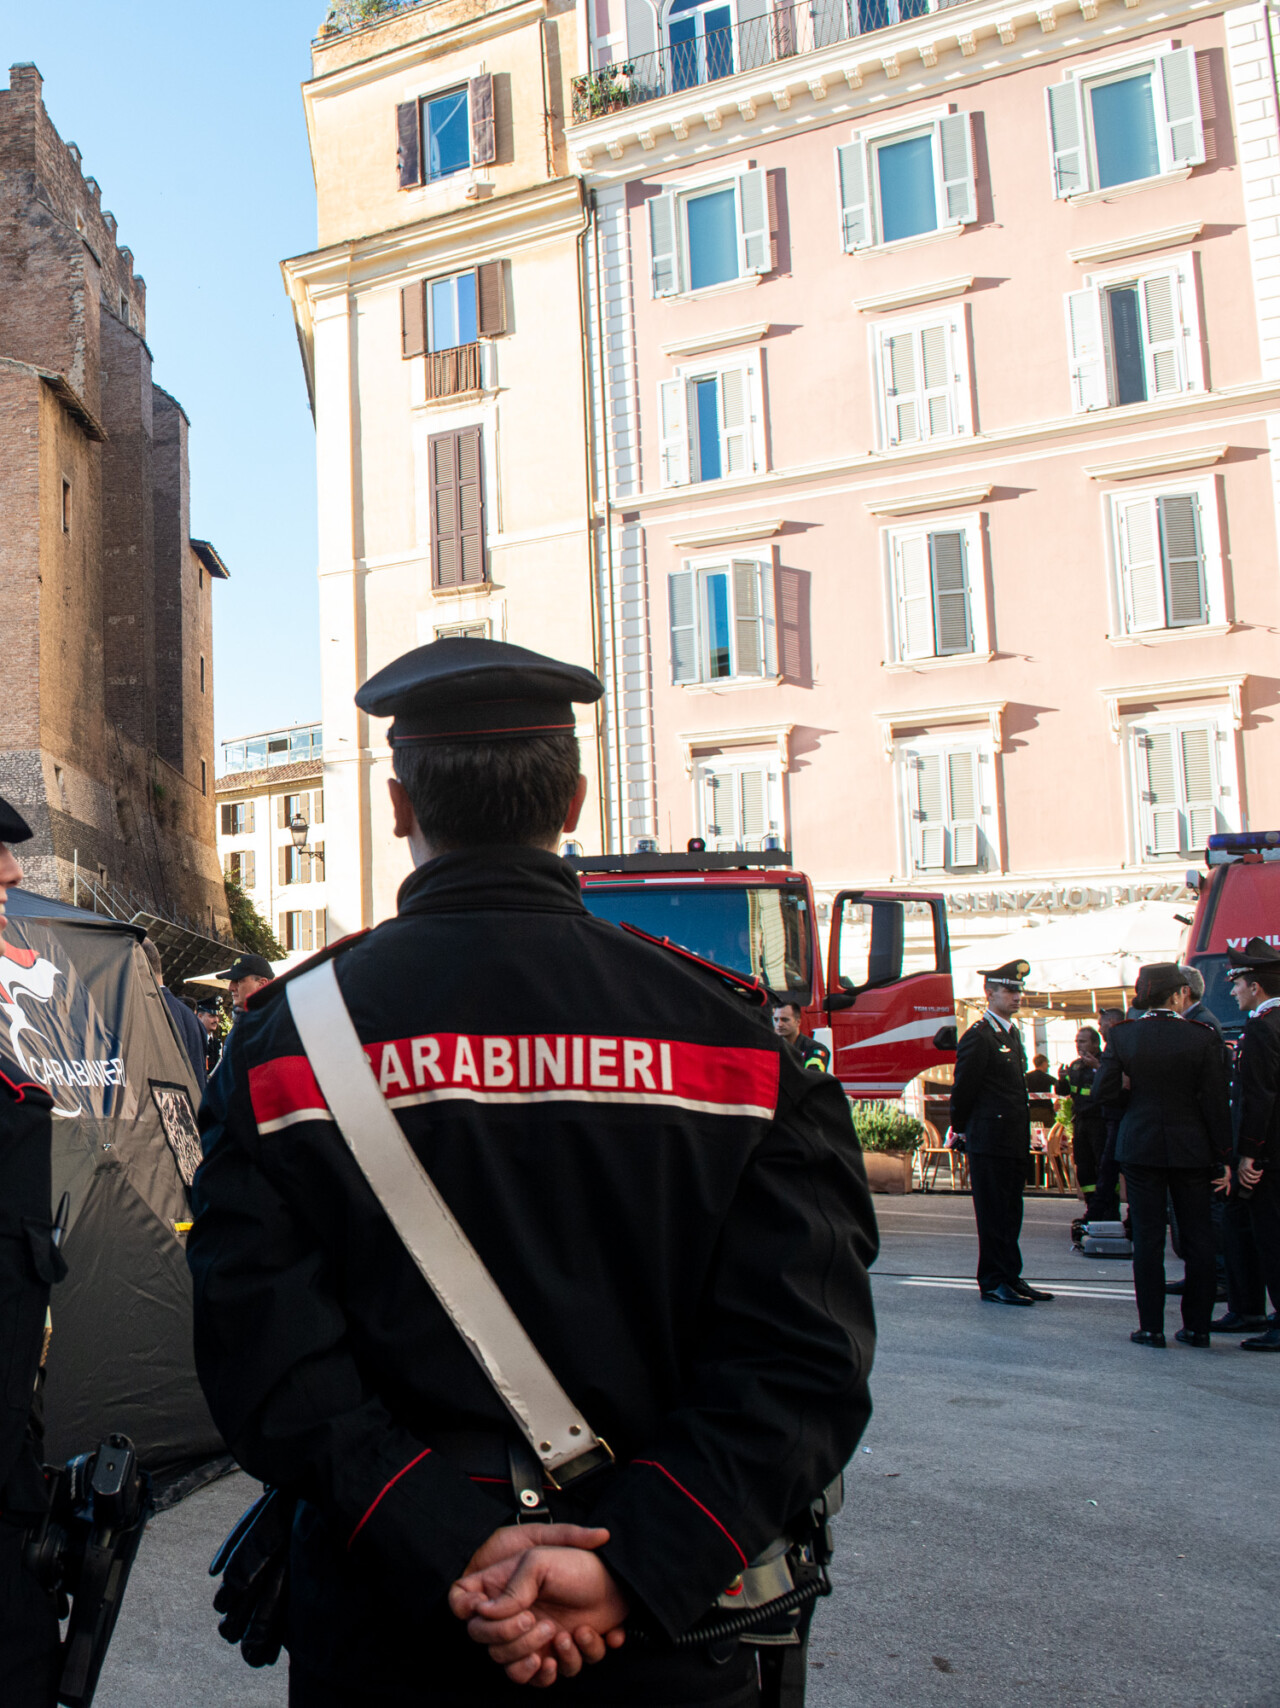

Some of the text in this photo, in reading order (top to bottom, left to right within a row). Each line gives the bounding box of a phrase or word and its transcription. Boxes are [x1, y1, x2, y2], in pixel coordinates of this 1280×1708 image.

[1226, 934, 1280, 949] VIIL
[29, 1056, 127, 1088] CARABINIERI
[362, 1035, 674, 1093] ARABINIERI
